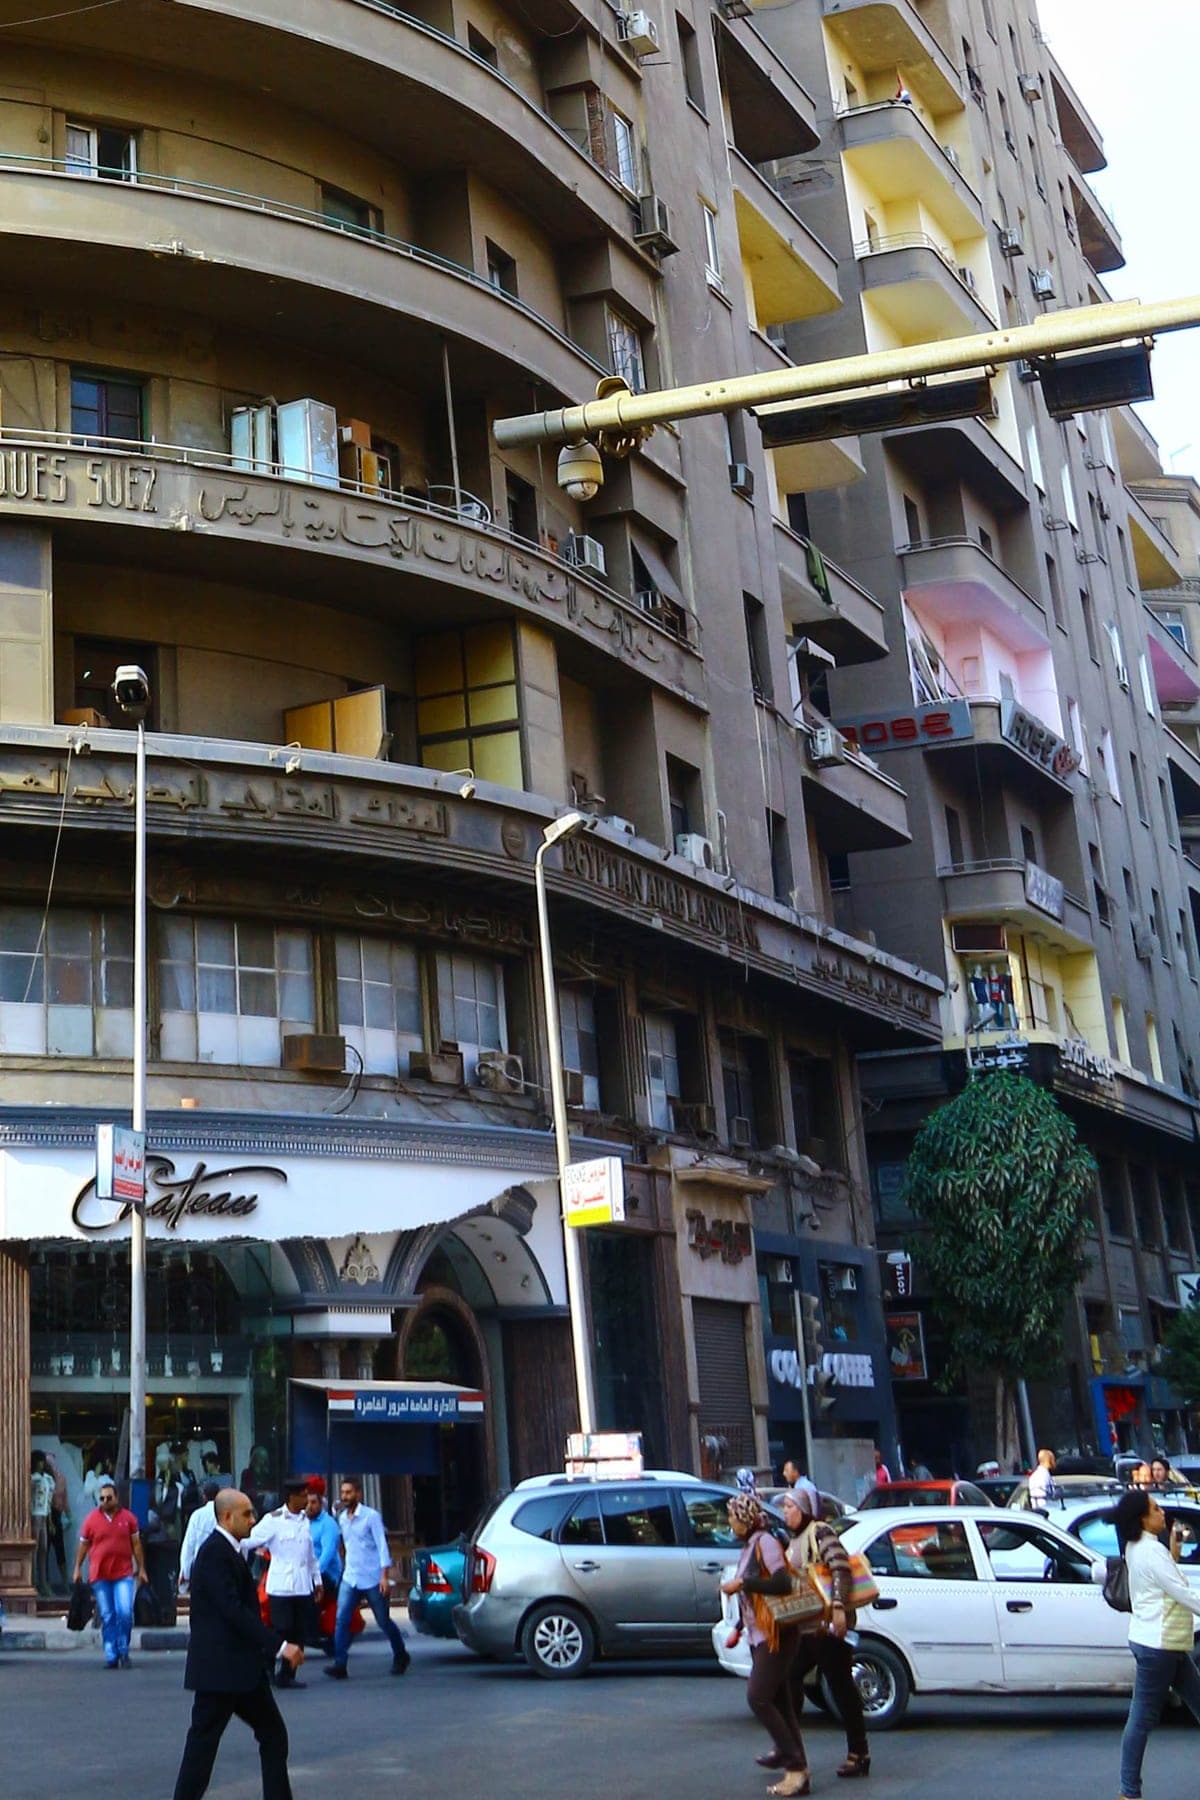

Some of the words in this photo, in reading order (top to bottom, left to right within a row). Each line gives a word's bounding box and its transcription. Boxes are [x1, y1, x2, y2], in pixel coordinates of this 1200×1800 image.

[87, 459, 158, 514] SUEZ
[198, 485, 295, 538] بالسويس
[561, 838, 644, 902] EGYPTIAN
[645, 871, 688, 920] ARAB
[687, 885, 725, 937] LAND
[723, 902, 762, 952] BANK
[71, 1154, 289, 1231] Cateau
[821, 1352, 876, 1388] COFFEE
[356, 1396, 387, 1417] القاهرة
